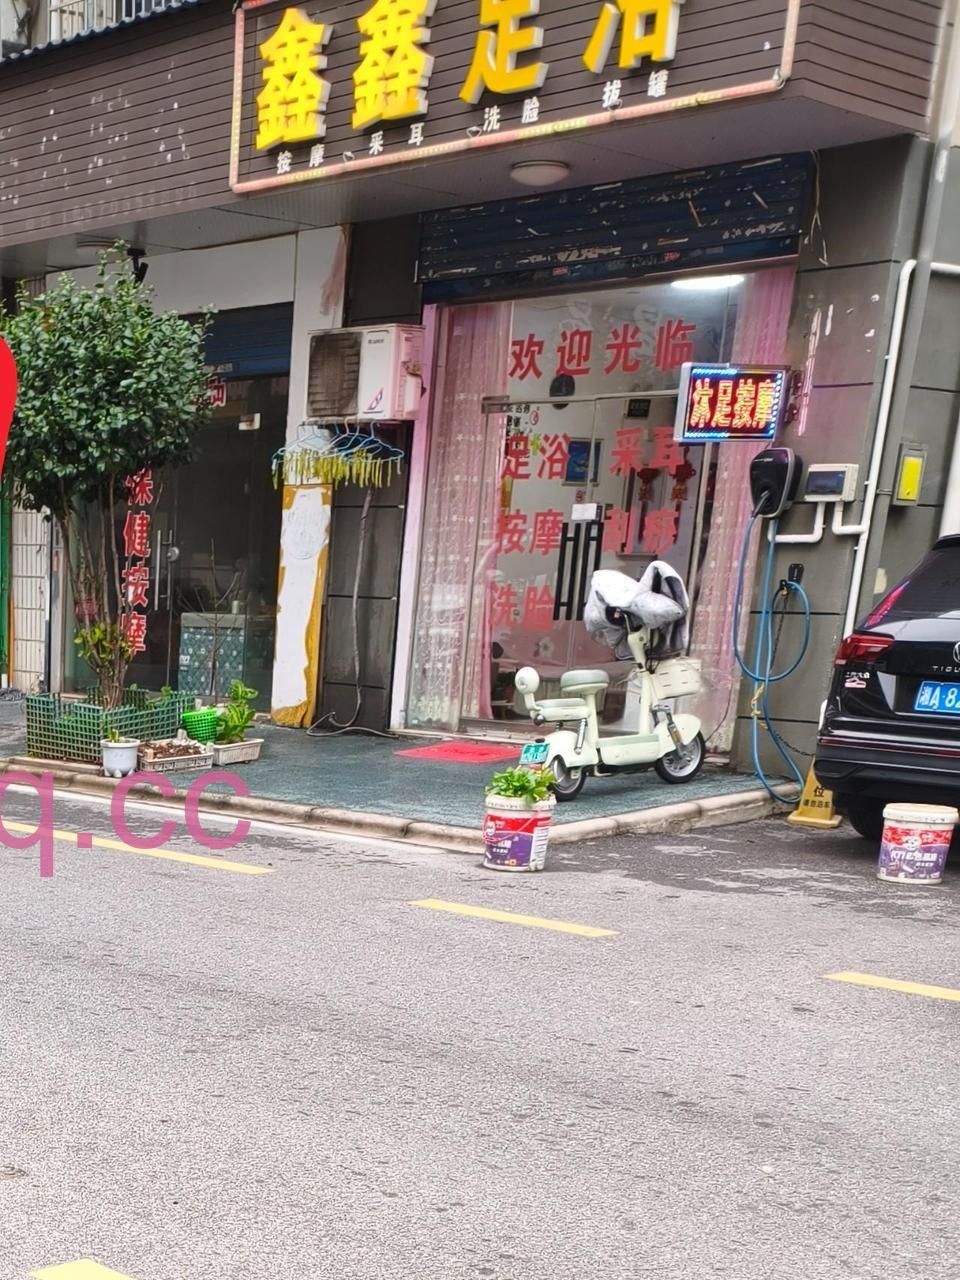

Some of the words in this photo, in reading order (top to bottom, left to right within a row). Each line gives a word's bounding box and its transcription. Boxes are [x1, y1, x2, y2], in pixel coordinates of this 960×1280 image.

[276, 143, 325, 175] 按摩
[369, 121, 425, 155] 采耳
[483, 98, 540, 132] 洗脸
[601, 70, 669, 107] 拔罐
[509, 319, 697, 379] 欢迎光临
[690, 377, 776, 429] 沐足按摩
[500, 432, 571, 480] 足浴
[608, 426, 685, 478] 采耳
[496, 508, 564, 556] 按摩
